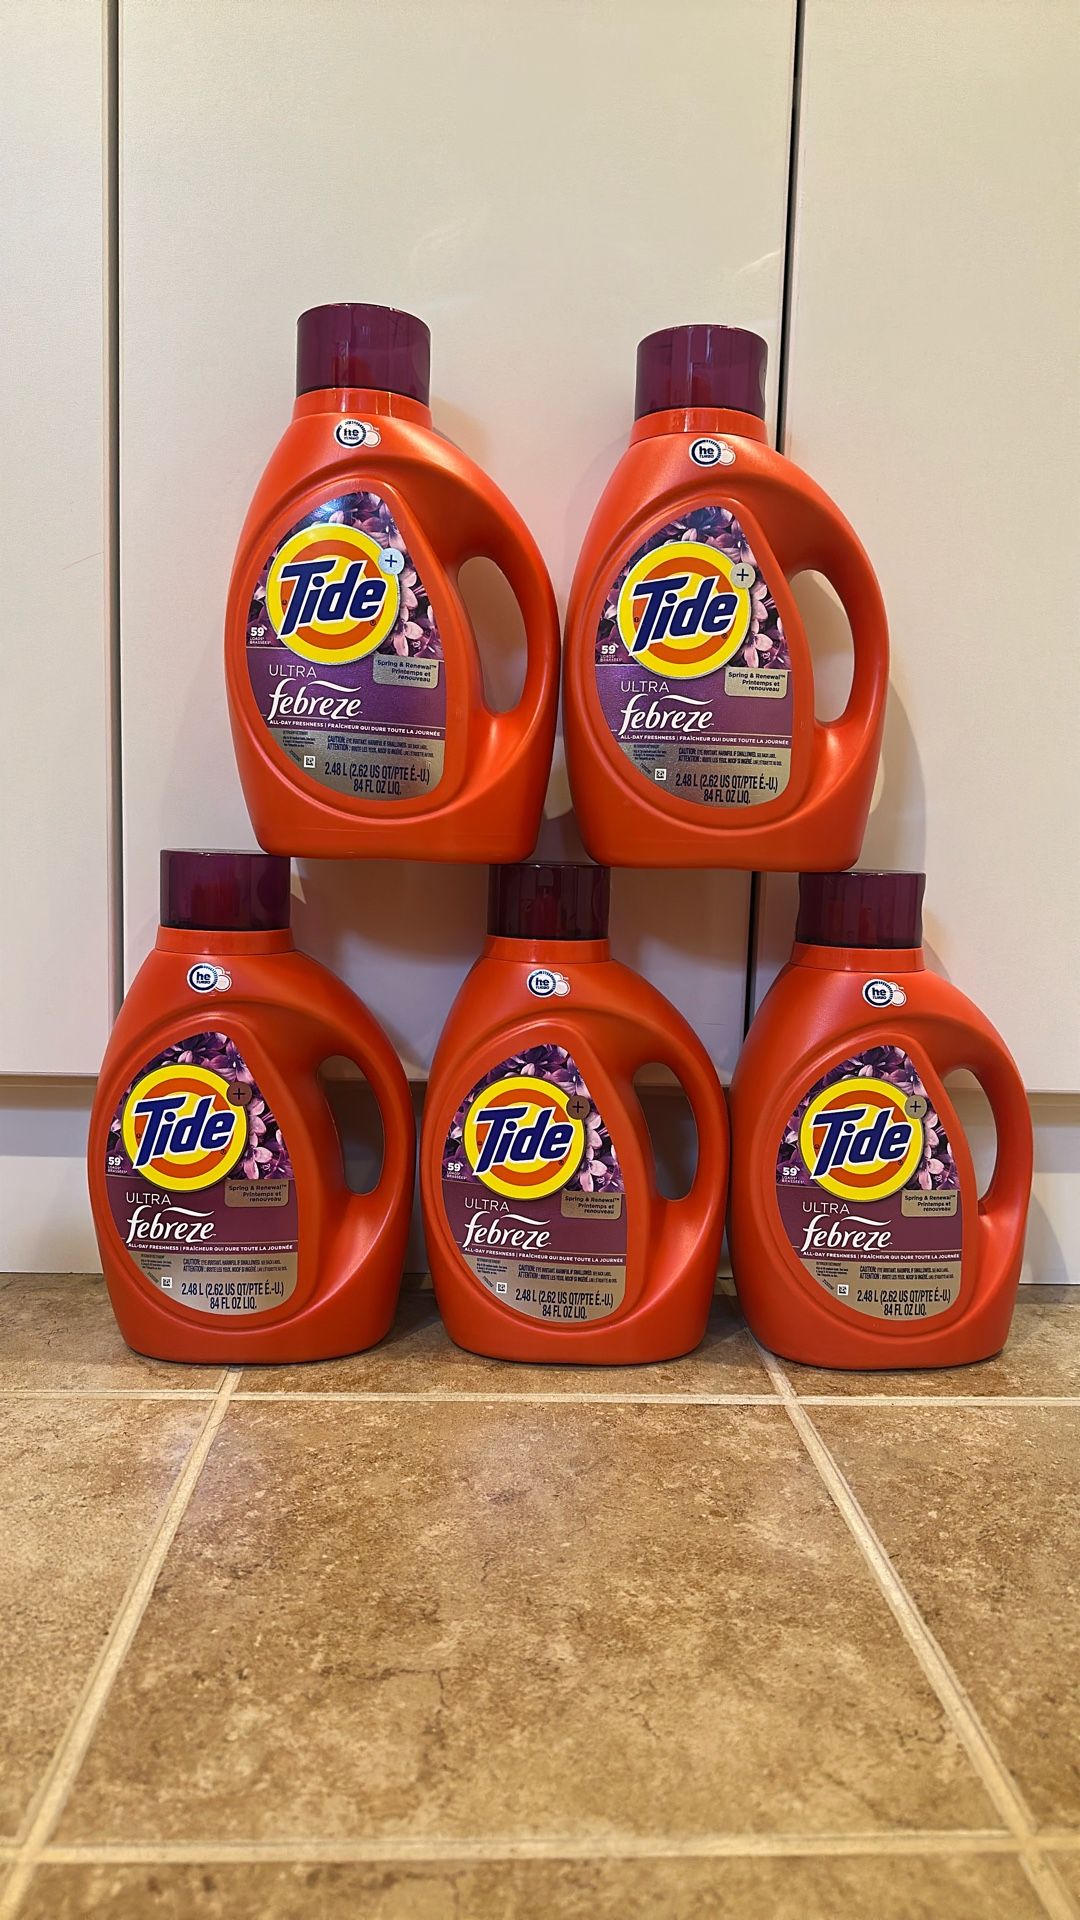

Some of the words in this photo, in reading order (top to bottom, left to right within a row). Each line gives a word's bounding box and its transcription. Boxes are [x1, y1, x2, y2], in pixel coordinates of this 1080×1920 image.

[699, 446, 714, 454] he
[280, 559, 387, 636] Tide
[632, 576, 739, 653] Tide
[250, 627, 265, 637] 59
[602, 644, 616, 654] 59
[377, 660, 398, 668] Spring
[269, 664, 317, 678] ULTRA
[391, 668, 422, 677] Printemps
[621, 680, 669, 693] ULTRA
[742, 679, 772, 687] Printemps
[267, 678, 362, 720] febreze
[619, 693, 713, 736] febreze
[328, 722, 359, 730] FRAÎCHEUR
[325, 762, 341, 776] 2.48
[343, 763, 347, 776] L
[350, 763, 368, 780] (2.62
[370, 765, 380, 778] US
[382, 766, 409, 780] QT/PTE
[354, 779, 363, 792] 84
[365, 780, 373, 793] FL
[376, 780, 385, 793] OZ
[387, 781, 402, 795] LIQ.
[676, 774, 692, 787] 2.48
[693, 774, 698, 787] L
[700, 774, 718, 790] (2.62
[720, 775, 730, 788] US
[732, 776, 758, 789] QT/PTE
[704, 789, 713, 802] 84
[715, 790, 723, 802] FL
[726, 790, 735, 802] OZ
[737, 791, 751, 804] LIQ.
[196, 971, 210, 980] he
[536, 977, 549, 986] he
[872, 987, 886, 996] he
[133, 1096, 236, 1169] Tide
[475, 1105, 575, 1174] Tide
[812, 1106, 913, 1177] Tide
[107, 1157, 121, 1166] 59
[447, 1162, 461, 1172] 59
[783, 1167, 797, 1176] 59
[125, 1193, 171, 1205] ULTRA
[465, 1198, 510, 1212] ULTRA
[565, 1195, 584, 1203] Spring
[578, 1202, 606, 1210] Printemps
[803, 1202, 850, 1214] ULTRA
[126, 1206, 215, 1243] febreze
[462, 1211, 551, 1250] febreze
[801, 1214, 892, 1251] febreze
[181, 1283, 198, 1295] 2.48
[199, 1283, 203, 1295] L
[205, 1283, 223, 1298] (2.62
[225, 1283, 235, 1296] US
[237, 1283, 263, 1295] QT/PTE
[515, 1288, 531, 1302] 2.48
[532, 1290, 537, 1302] L
[539, 1290, 556, 1306] (2.62
[557, 1291, 567, 1304] US
[569, 1292, 594, 1306] QT/PTE
[210, 1297, 220, 1309] 84
[221, 1297, 230, 1309] FL
[231, 1297, 241, 1309] OZ
[243, 1297, 257, 1310] LIQ.
[857, 1290, 873, 1302] 2.48
[874, 1291, 878, 1302] L
[880, 1290, 897, 1305] (2.62
[899, 1290, 908, 1303] US
[909, 1290, 933, 1303] QT/PTE
[542, 1305, 551, 1317] 84
[553, 1305, 561, 1317] FL
[563, 1306, 572, 1318] OZ
[574, 1306, 587, 1320] LIQ.
[884, 1304, 893, 1316] 84
[894, 1304, 902, 1316] FL
[904, 1304, 913, 1315] OZ
[914, 1304, 927, 1316] LIQ.
